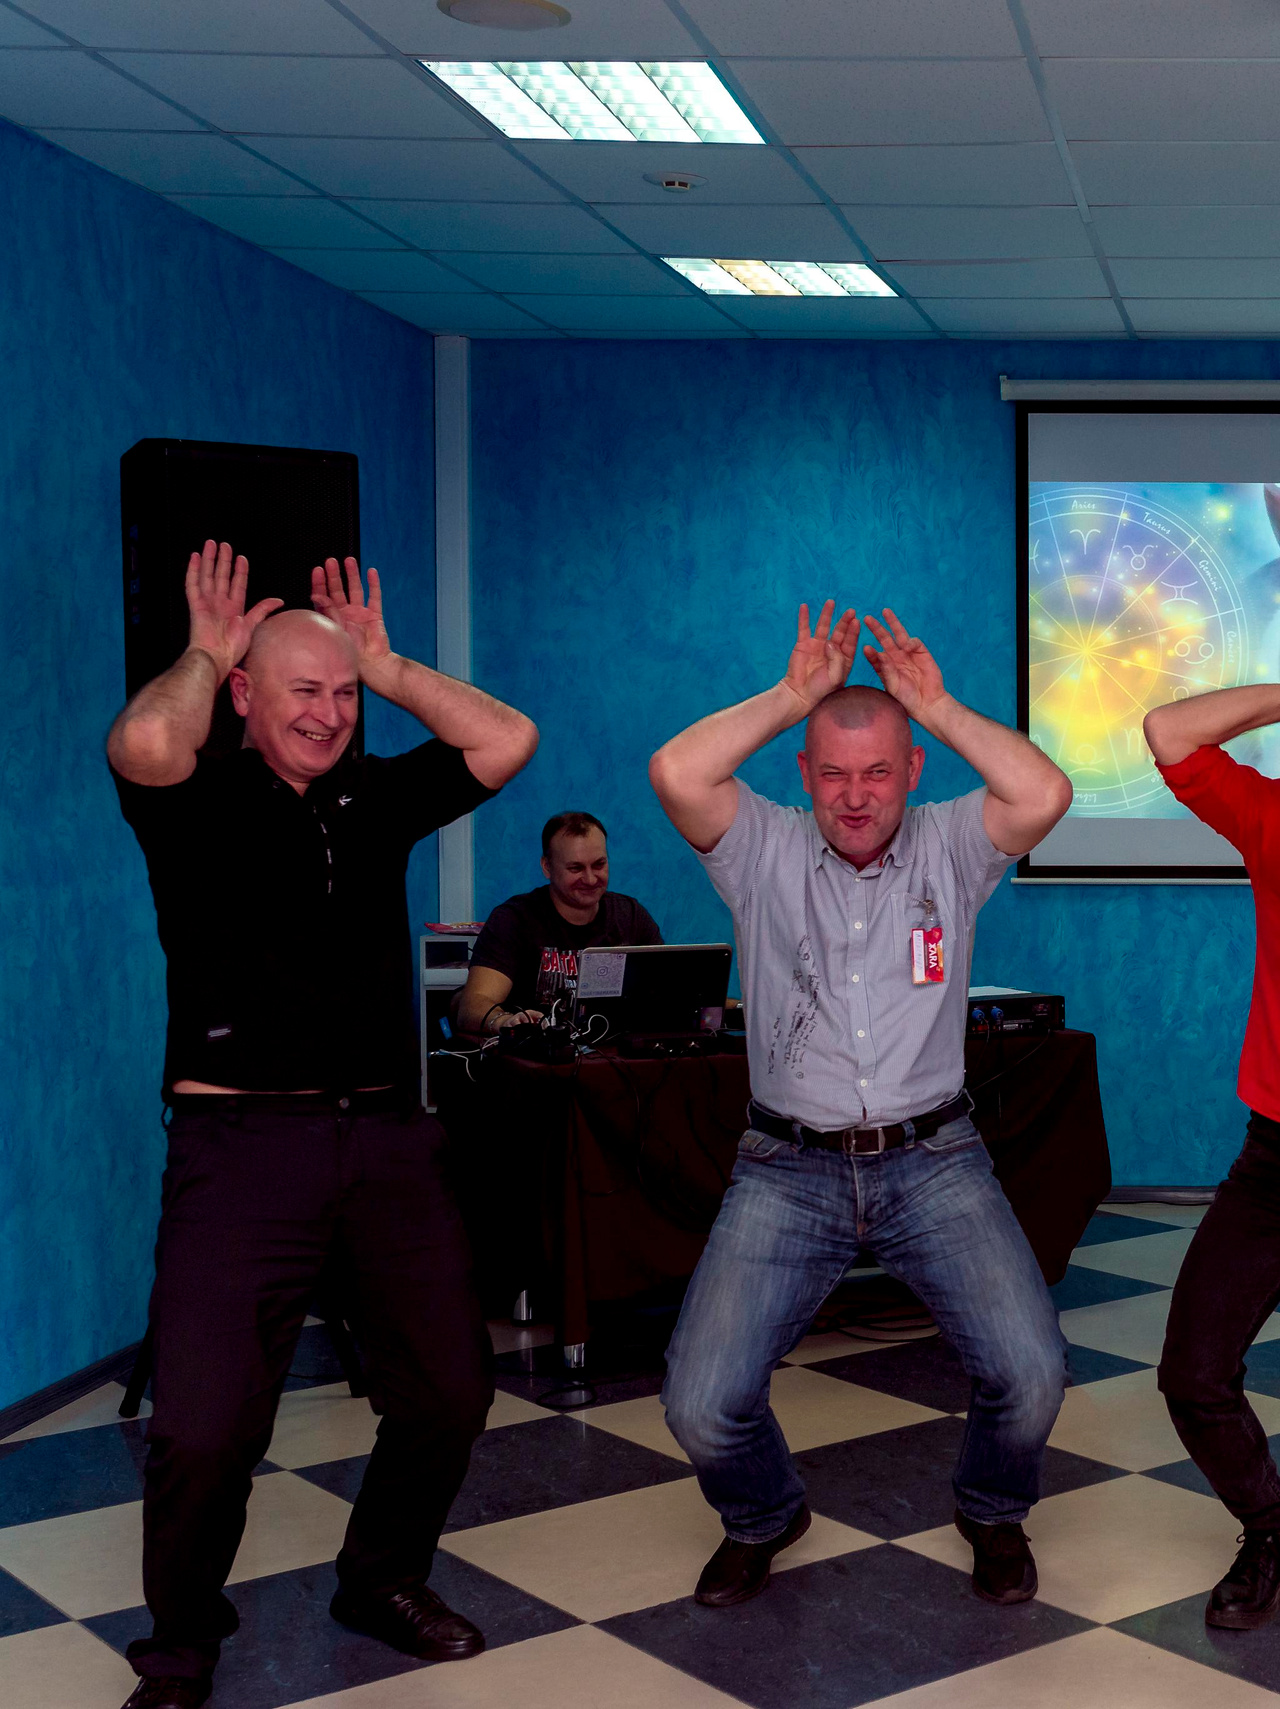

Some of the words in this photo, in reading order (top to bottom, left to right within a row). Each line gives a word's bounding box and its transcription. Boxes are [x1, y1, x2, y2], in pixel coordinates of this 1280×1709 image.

[1071, 499, 1096, 511] Aries
[1142, 511, 1171, 535] Taurus
[1198, 559, 1222, 592] Gemini
[541, 947, 579, 976] SATA
[929, 942, 937, 968] XARA
